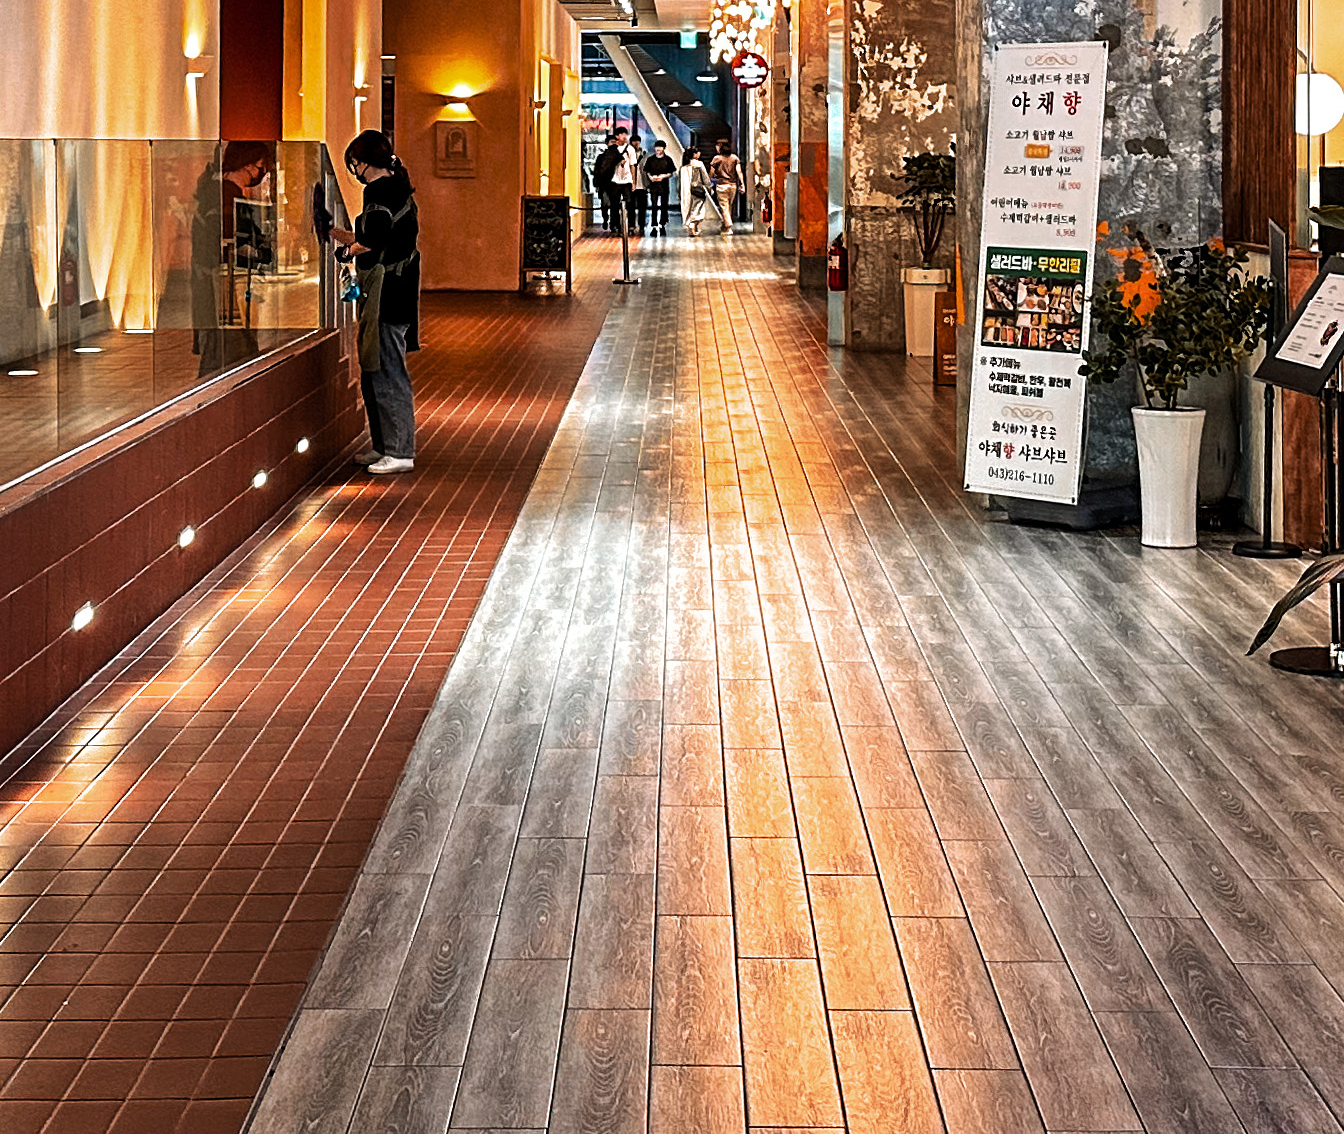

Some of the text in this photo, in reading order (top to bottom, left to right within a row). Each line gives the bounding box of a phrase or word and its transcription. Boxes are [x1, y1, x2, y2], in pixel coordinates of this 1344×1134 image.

[991, 420, 1028, 435] 회식하기
[978, 440, 1068, 464] 야채향 샤브샤브
[988, 466, 1055, 486] 043)216-1110
